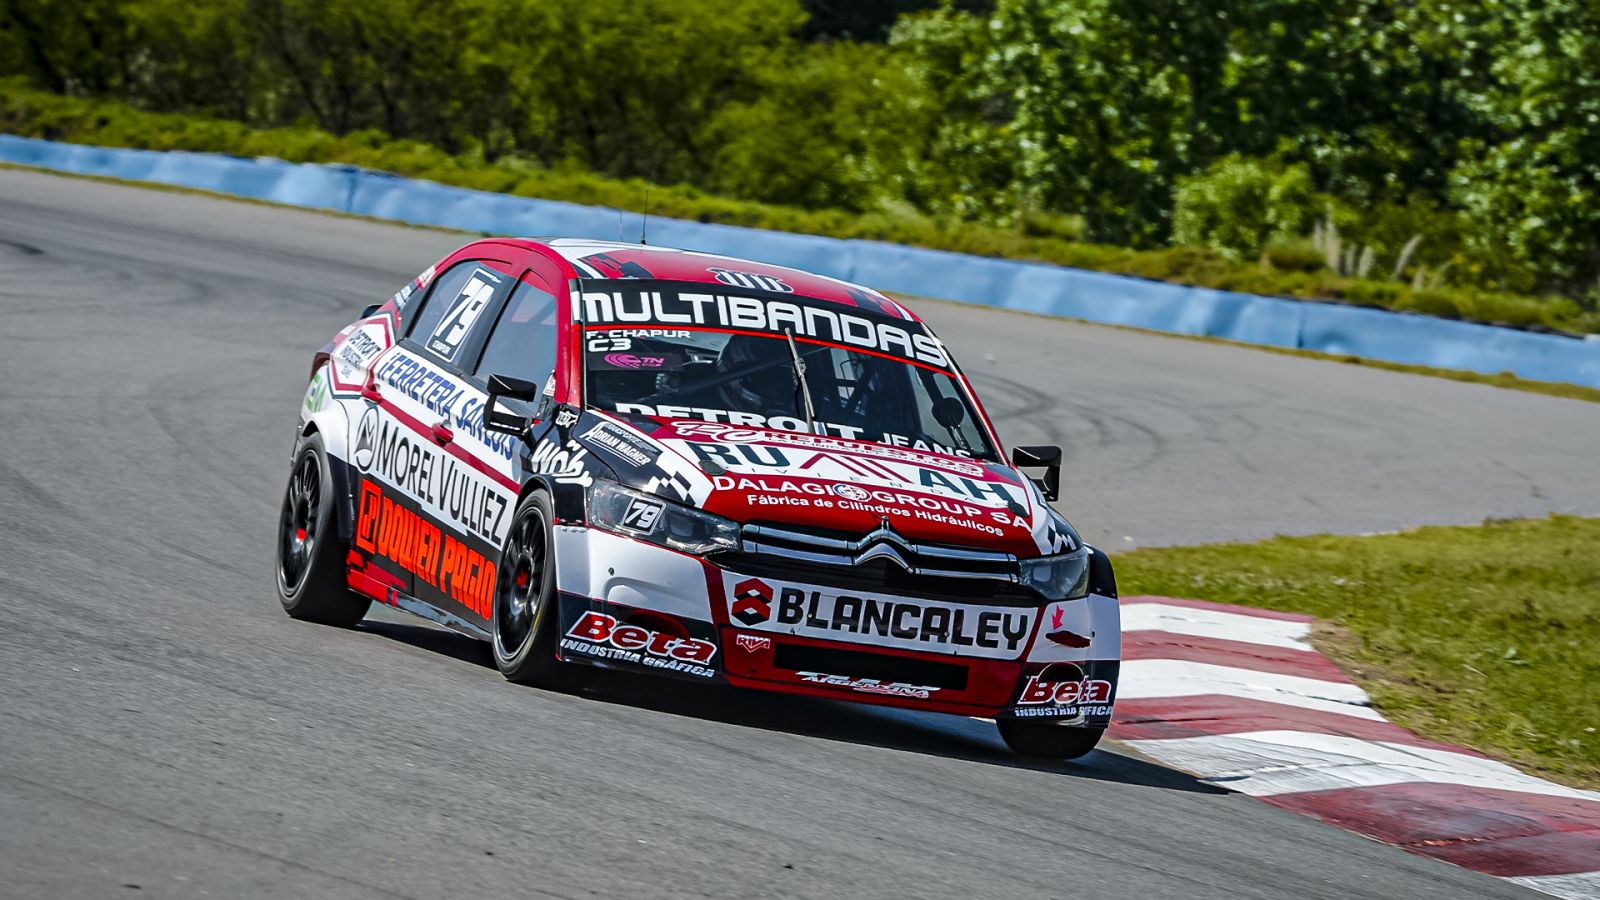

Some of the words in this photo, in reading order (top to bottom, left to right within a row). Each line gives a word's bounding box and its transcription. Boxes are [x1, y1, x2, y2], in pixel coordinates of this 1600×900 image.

[434, 277, 495, 347] 79
[571, 290, 948, 367] MULTIBANDAS
[609, 329, 691, 339] CHAPUR
[588, 338, 631, 352] C3
[579, 421, 620, 448] ADRIAN
[615, 440, 652, 466] WAGNER
[615, 402, 864, 441] DETROIT
[876, 432, 972, 458] JEANS
[376, 420, 433, 505] MOREL
[439, 454, 508, 547] VULLIEZ
[625, 501, 661, 529] 79
[747, 493, 810, 508] Fábrica
[813, 498, 834, 509] de
[838, 500, 911, 517] Cilindros
[915, 509, 1004, 537] Hidráulicos
[871, 489, 983, 518] GROUP
[989, 511, 1033, 533] SA
[566, 611, 718, 666] Beta
[776, 586, 1029, 651] BLANCALEY
[560, 638, 641, 664] INDUSTRIA
[1014, 706, 1077, 717] INDUSTRIA
[1017, 675, 1112, 705] Beta
